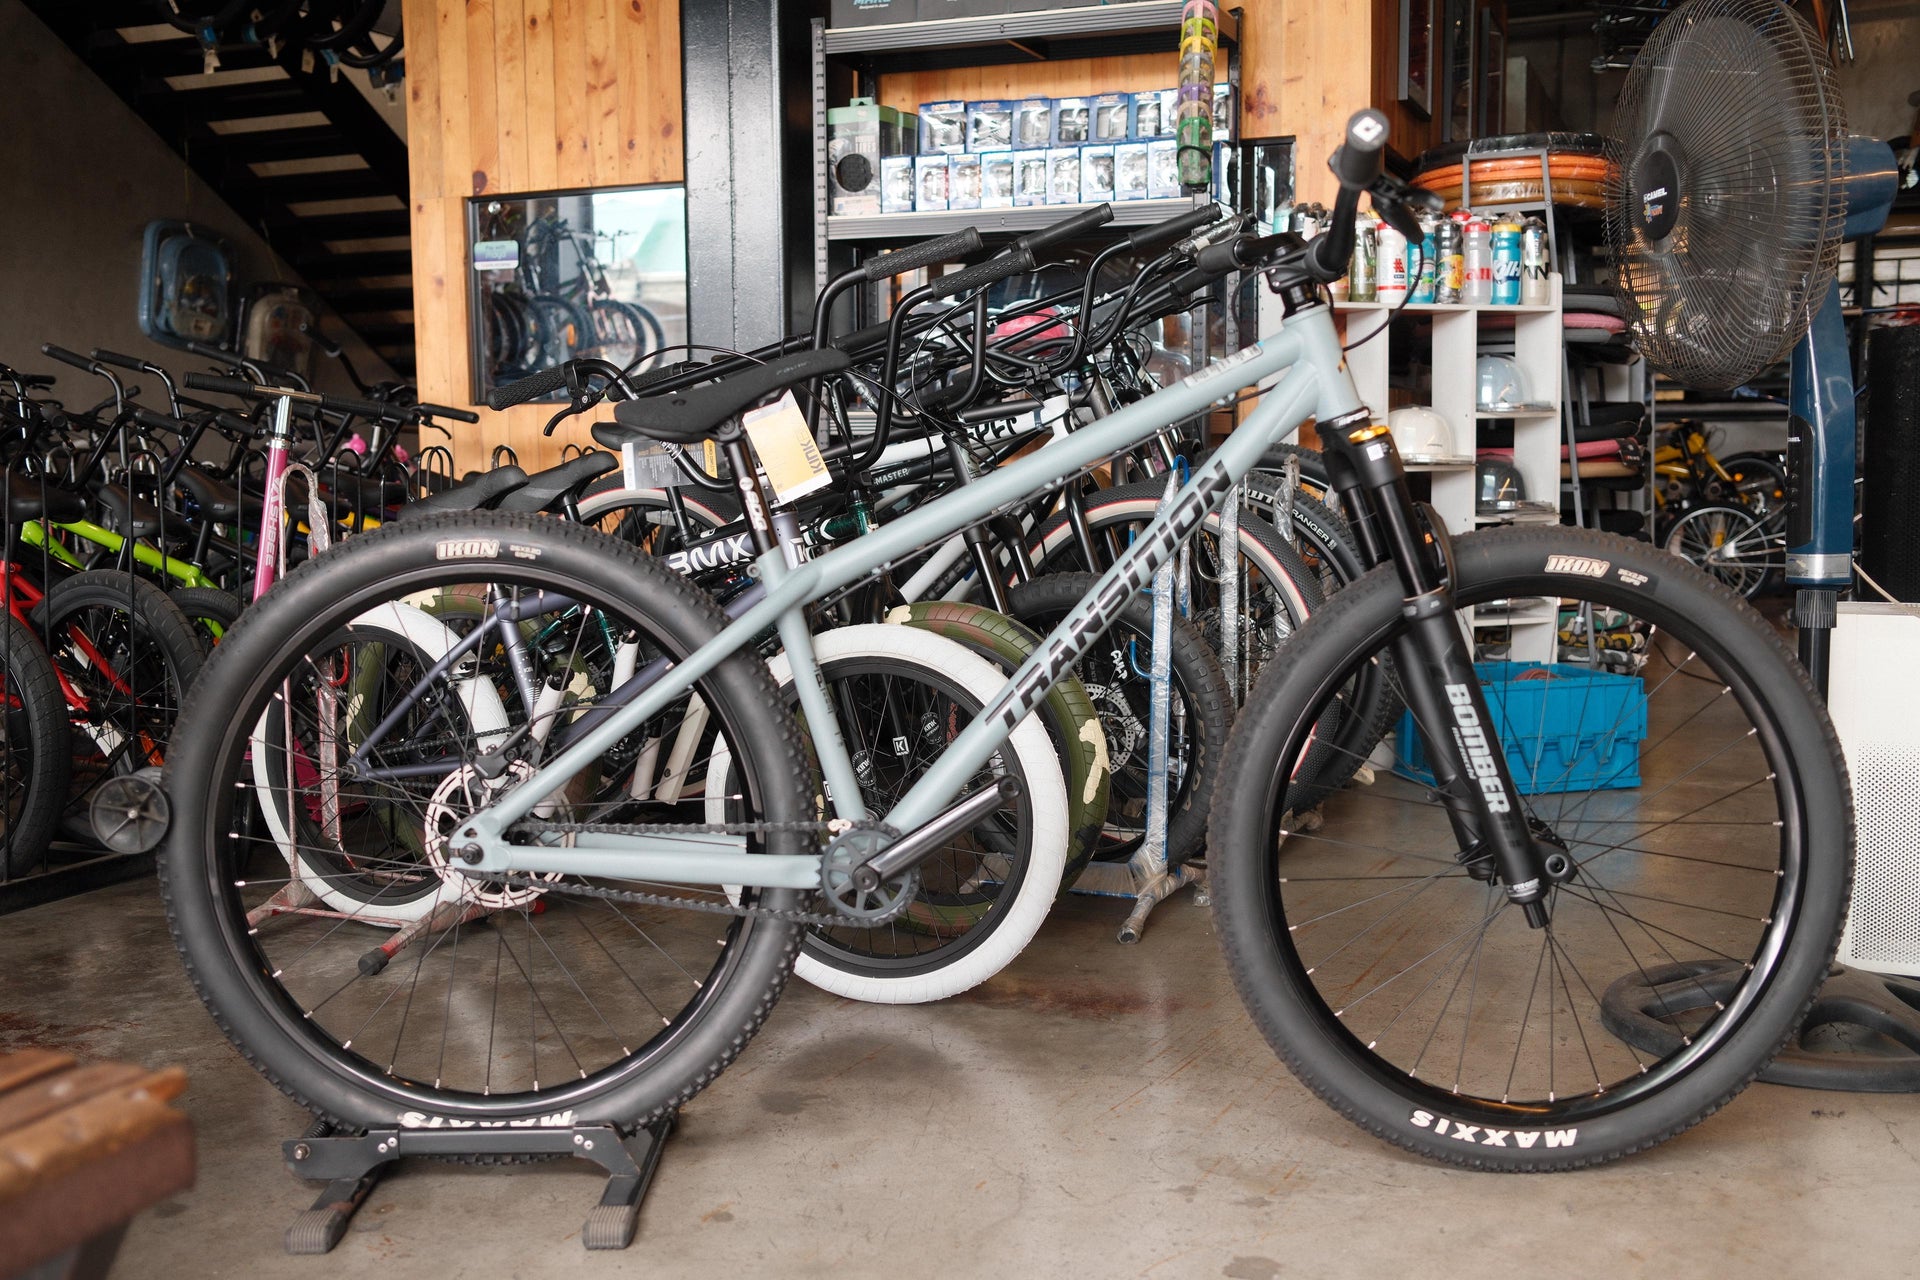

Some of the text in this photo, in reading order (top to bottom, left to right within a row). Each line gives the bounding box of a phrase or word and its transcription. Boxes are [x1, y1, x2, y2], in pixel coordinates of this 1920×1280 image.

[436, 540, 499, 560] IKON
[1544, 555, 1610, 578] IKON
[984, 459, 1232, 730] TRANSITION
[1444, 683, 1511, 814] BOMBER
[1451, 727, 1476, 780] marzocchi
[1409, 1109, 1578, 1149] MAXXIS
